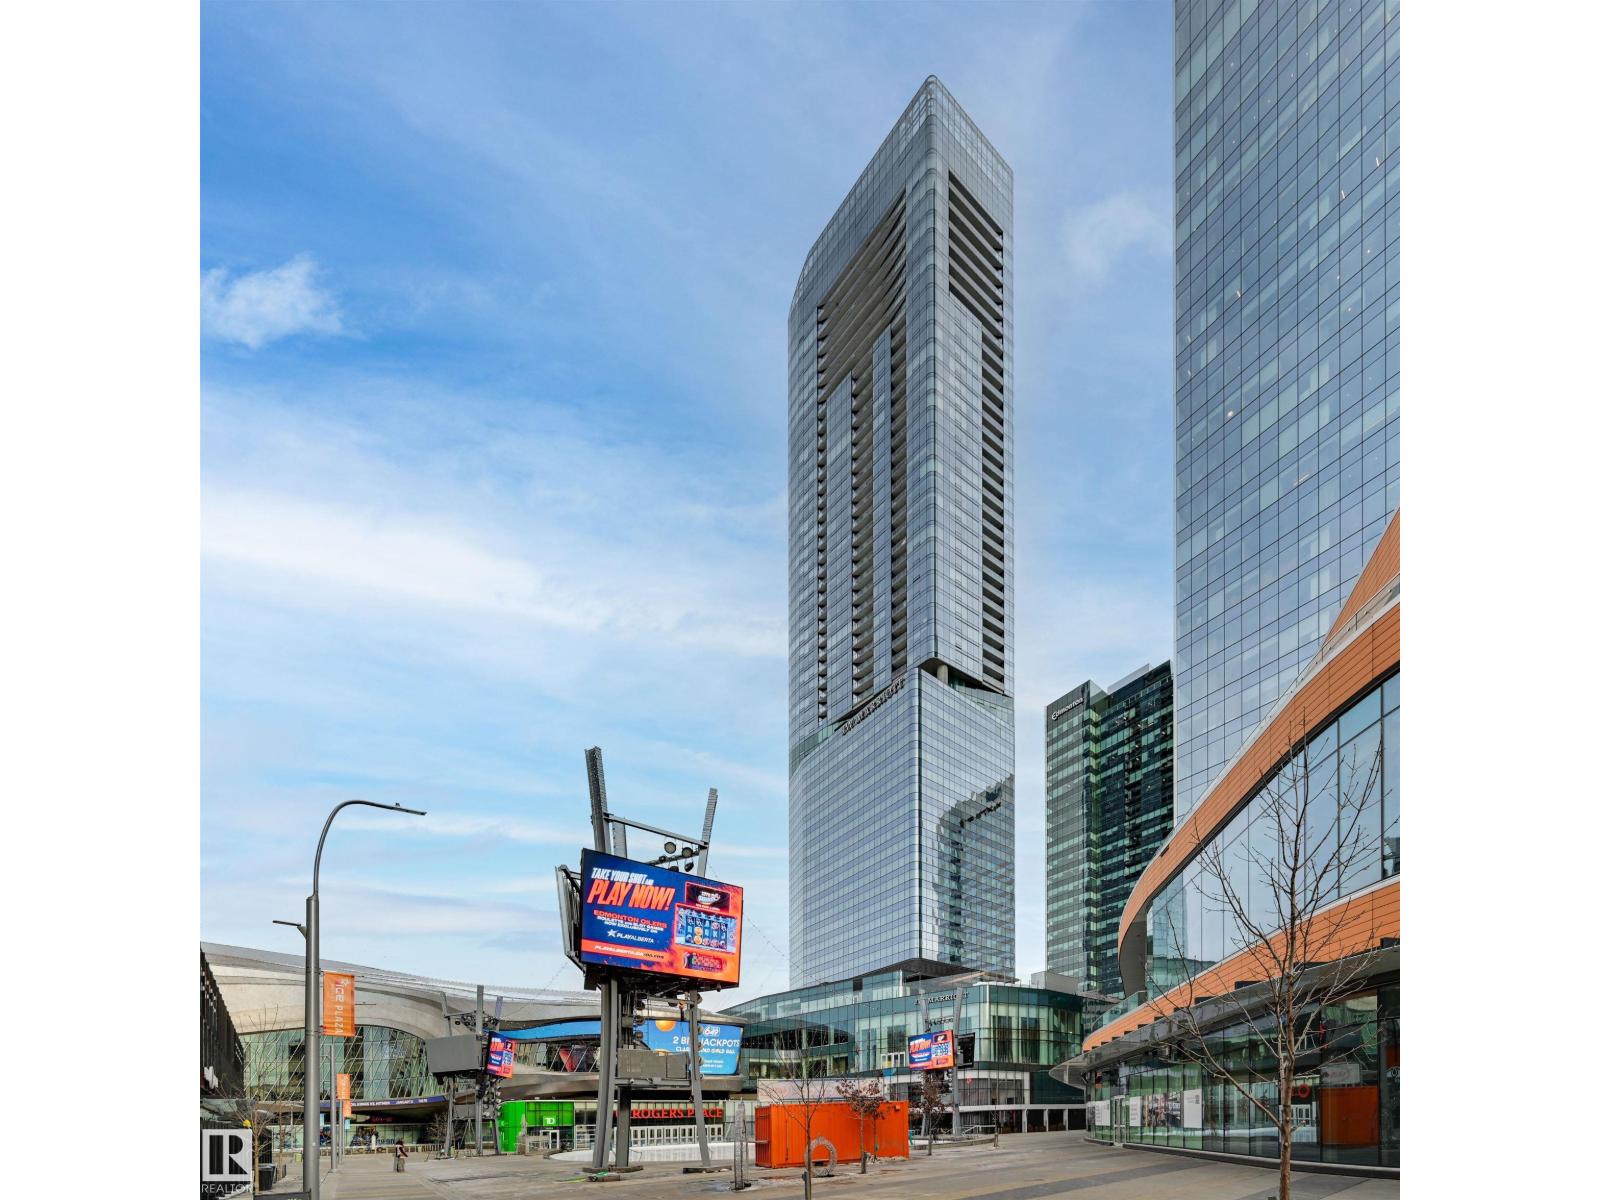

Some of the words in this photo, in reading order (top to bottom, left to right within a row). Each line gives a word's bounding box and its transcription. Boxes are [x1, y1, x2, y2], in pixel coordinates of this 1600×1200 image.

[1052, 697, 1083, 720] Edmonton
[591, 867, 611, 880] TAKE
[610, 870, 630, 882] YOUR
[628, 873, 648, 884] SHOT
[587, 879, 633, 906] PLAY
[628, 884, 676, 911] NOW!
[594, 909, 640, 923] EDMONTON
[640, 918, 667, 929] OILERS
[335, 1005, 344, 1035] PLAZA
[673, 1036, 679, 1045] 2
[544, 1117, 555, 1125] TD
[632, 1108, 684, 1118] ROGERS
[687, 1107, 723, 1118] PACE
